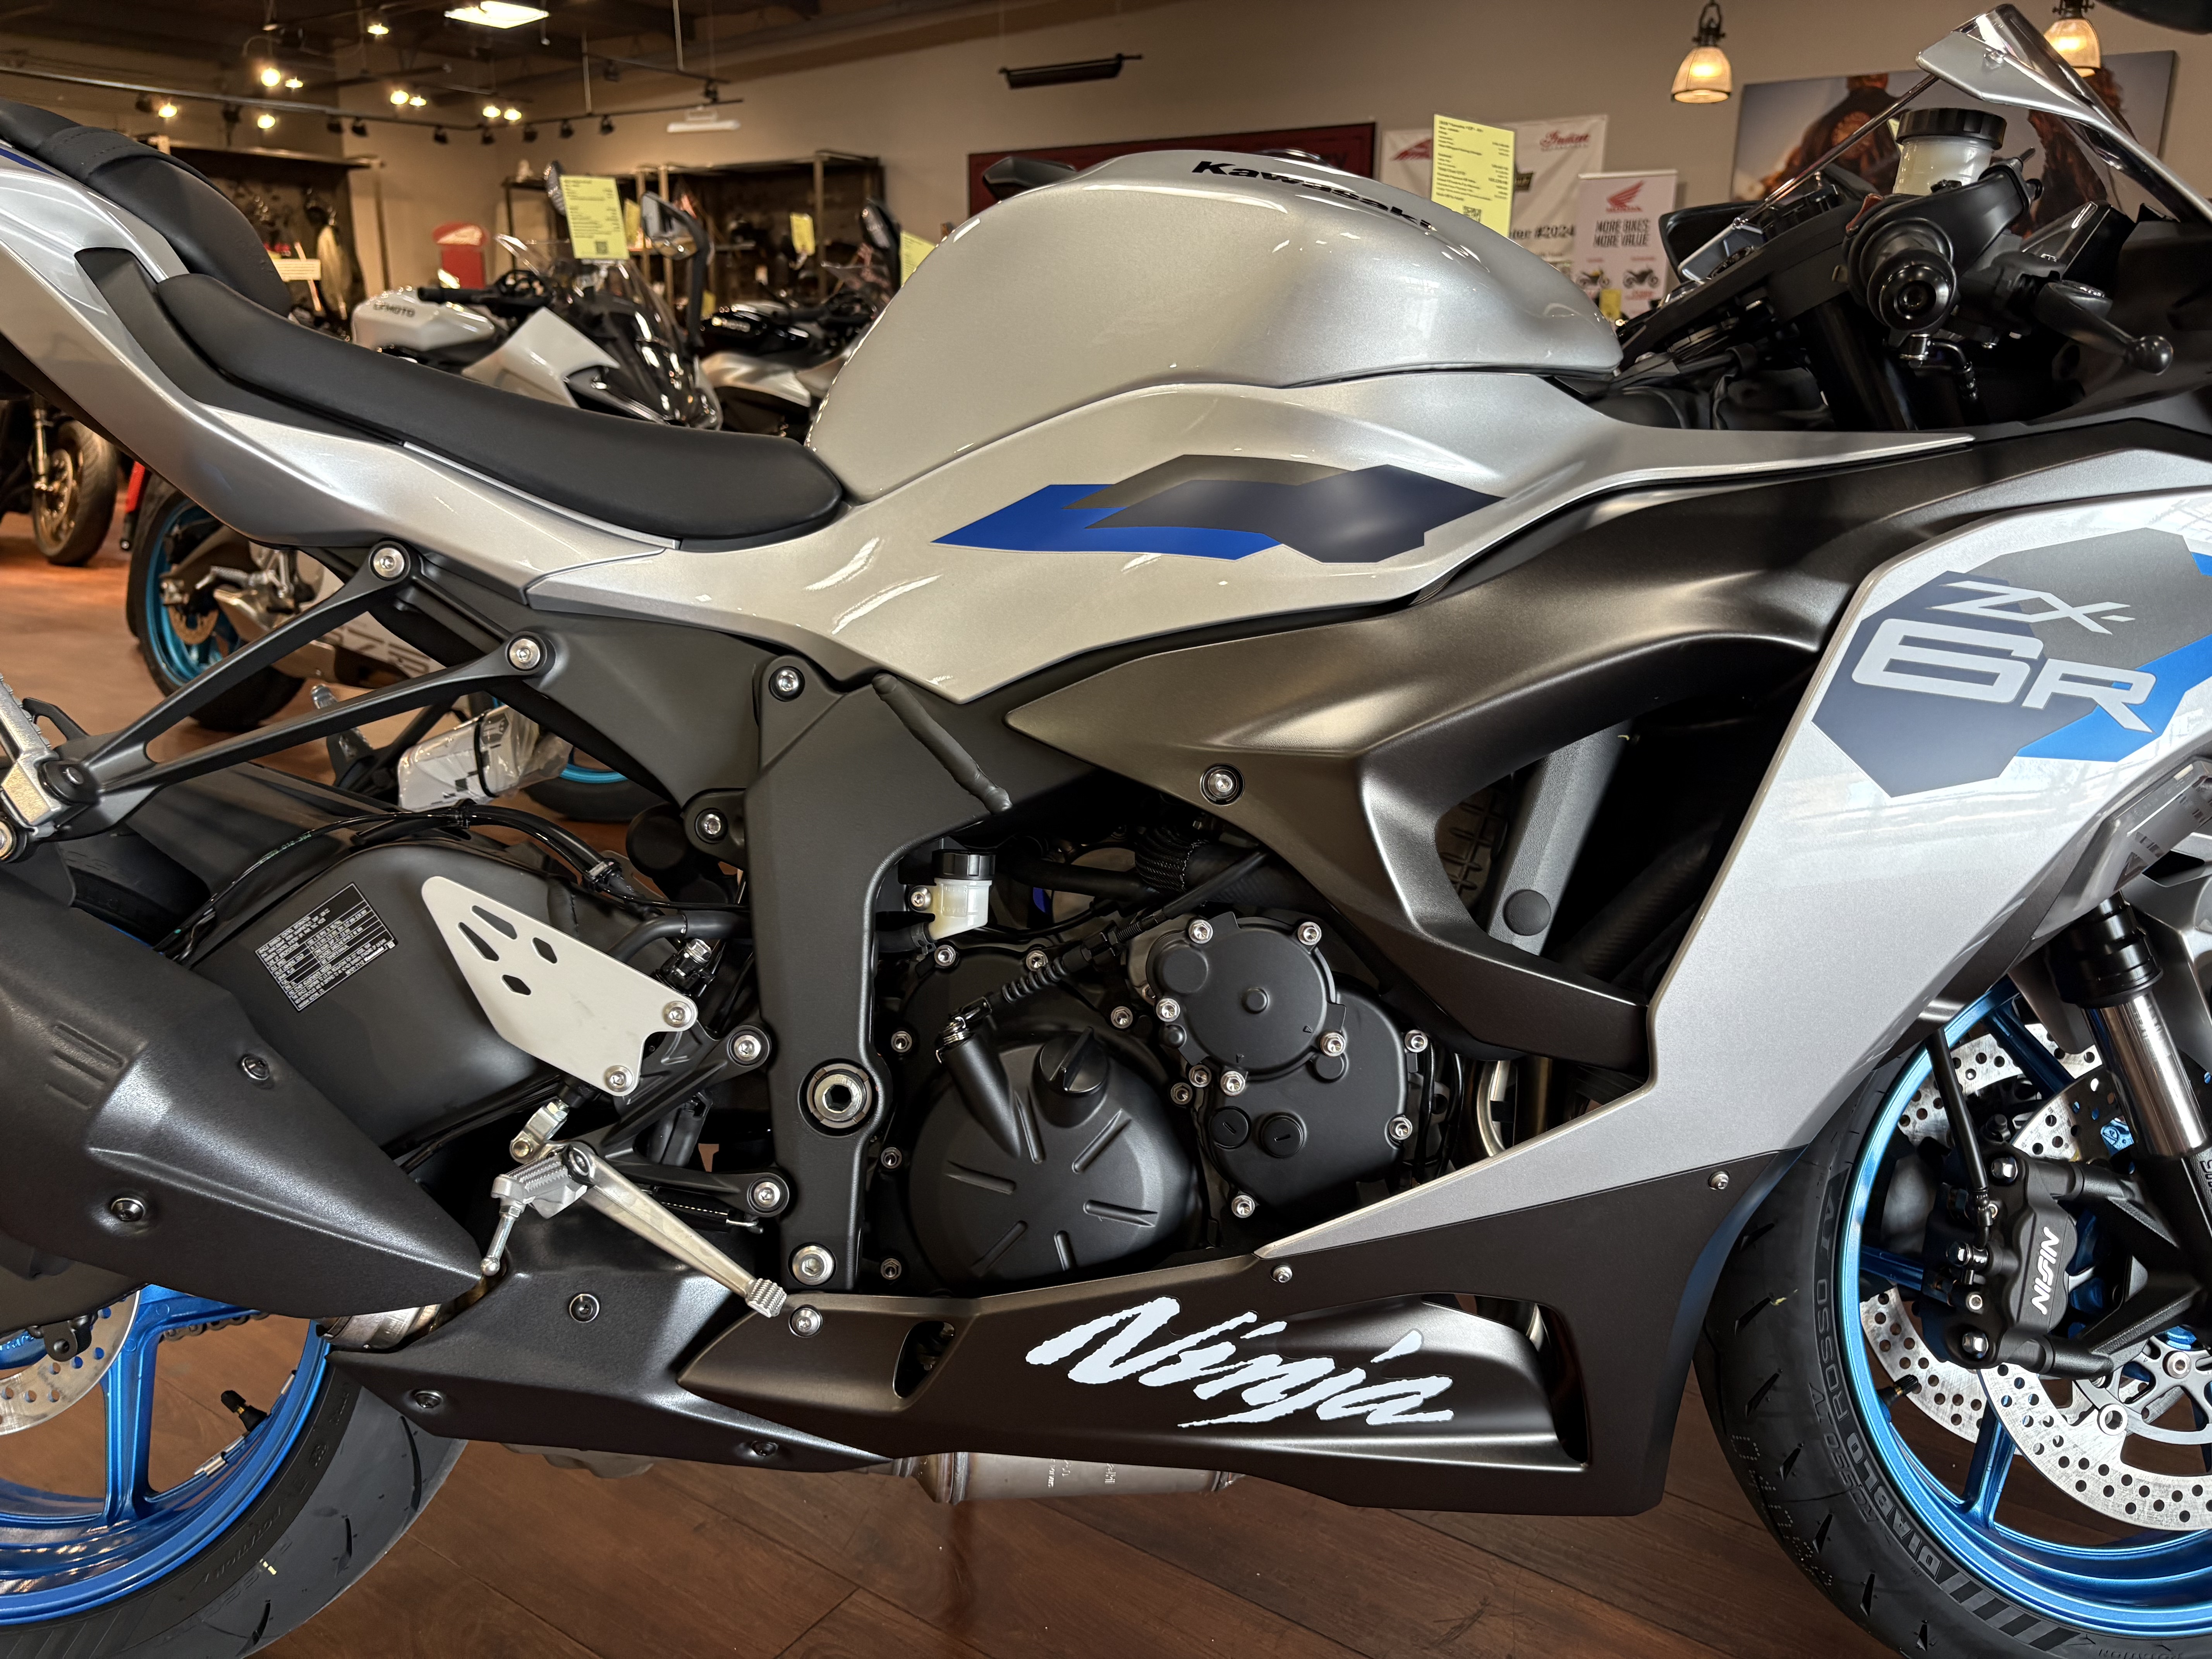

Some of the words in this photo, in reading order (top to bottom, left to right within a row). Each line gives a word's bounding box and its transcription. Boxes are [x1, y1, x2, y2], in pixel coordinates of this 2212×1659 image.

[1191, 161, 1434, 230] Kawasaki
[1593, 234, 1620, 248] MORE
[1595, 219, 1621, 233] MORE
[1851, 618, 2157, 735] 6R
[1025, 1295, 1454, 1428] Ninja
[1817, 1279, 1849, 1422] ROSSO
[1847, 1432, 1942, 1580] DIABLO
